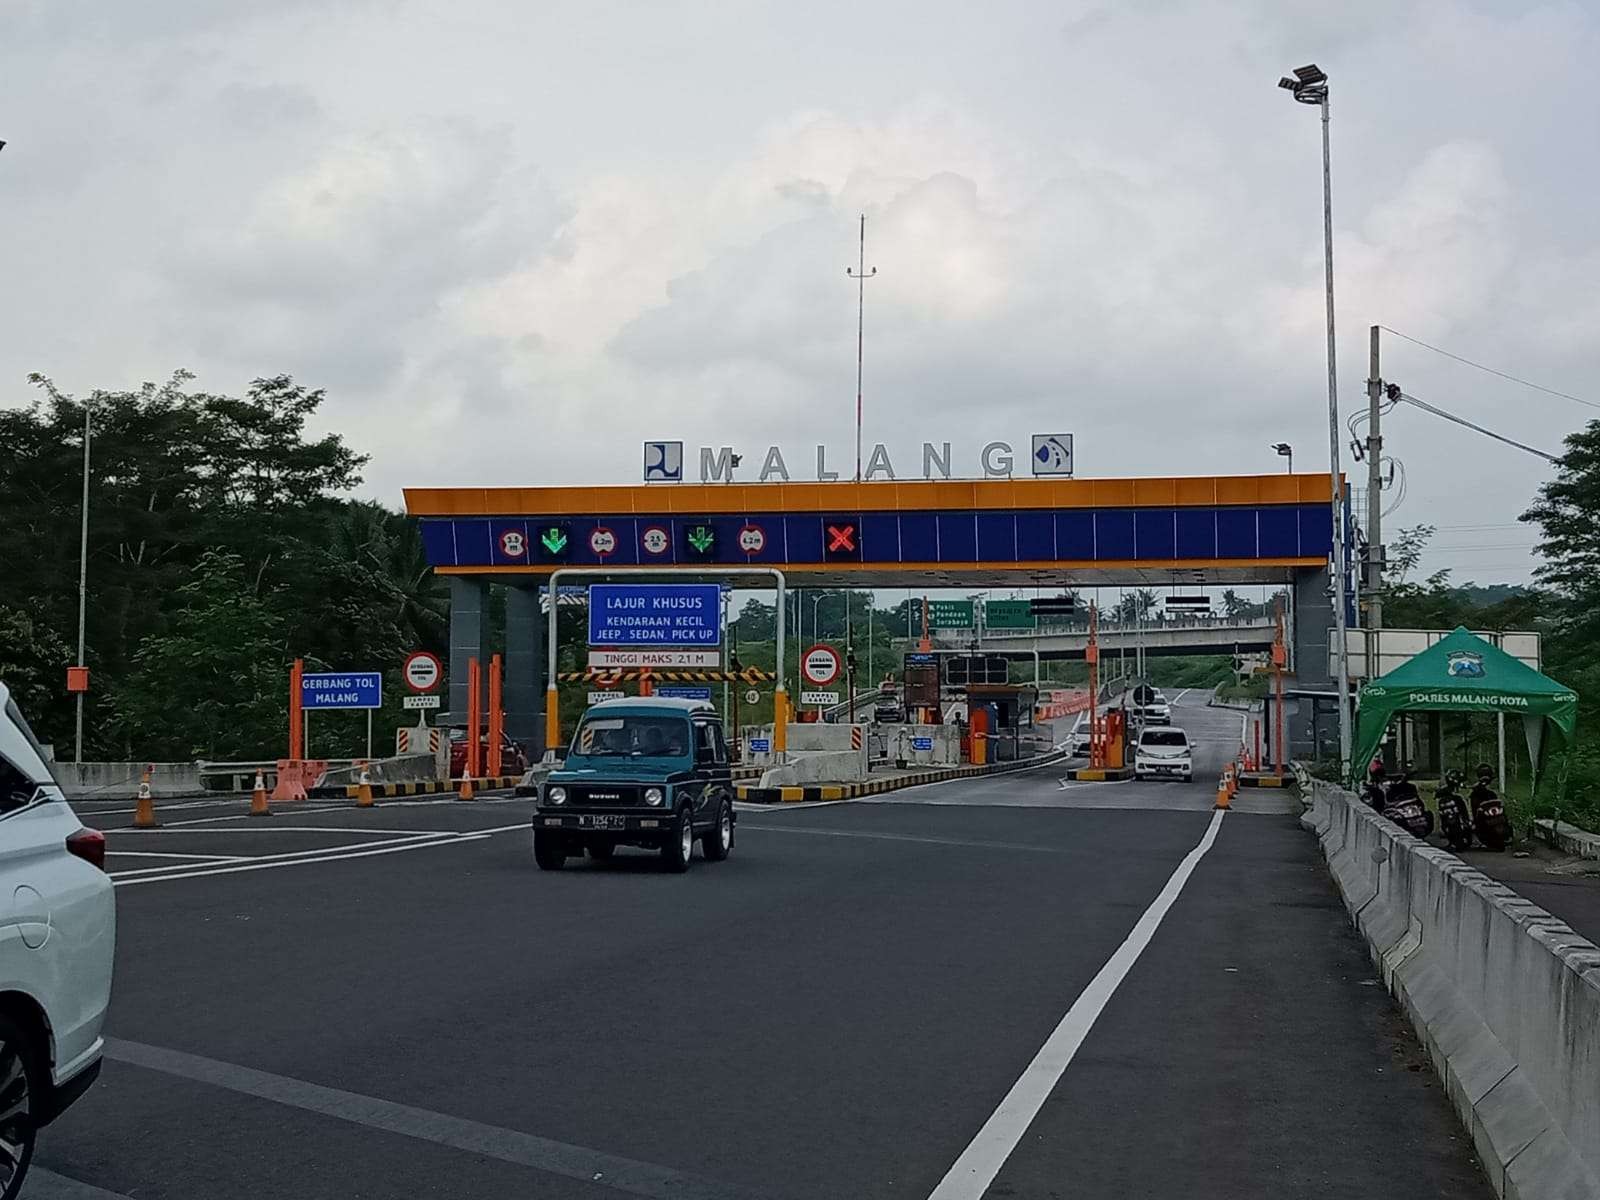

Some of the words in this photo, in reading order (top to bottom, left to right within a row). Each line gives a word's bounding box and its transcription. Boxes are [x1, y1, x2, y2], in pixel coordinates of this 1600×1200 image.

[700, 441, 1014, 482] MALANG
[607, 597, 646, 609] LAJUR
[653, 597, 703, 609] KHUSUS
[607, 617, 671, 626] KENDARAAN
[676, 616, 705, 626] KECIL
[672, 629, 696, 639] PICK
[699, 629, 714, 639] UP
[604, 654, 638, 664] TINGGI
[642, 654, 673, 664] MAKS
[695, 654, 704, 664] M
[303, 679, 351, 689] GERBANG
[356, 678, 375, 688] TOL
[315, 693, 359, 703] MALANG
[1409, 693, 1450, 704] POLRES
[1451, 694, 1499, 705] MALANG
[1500, 696, 1529, 706] KOTA
